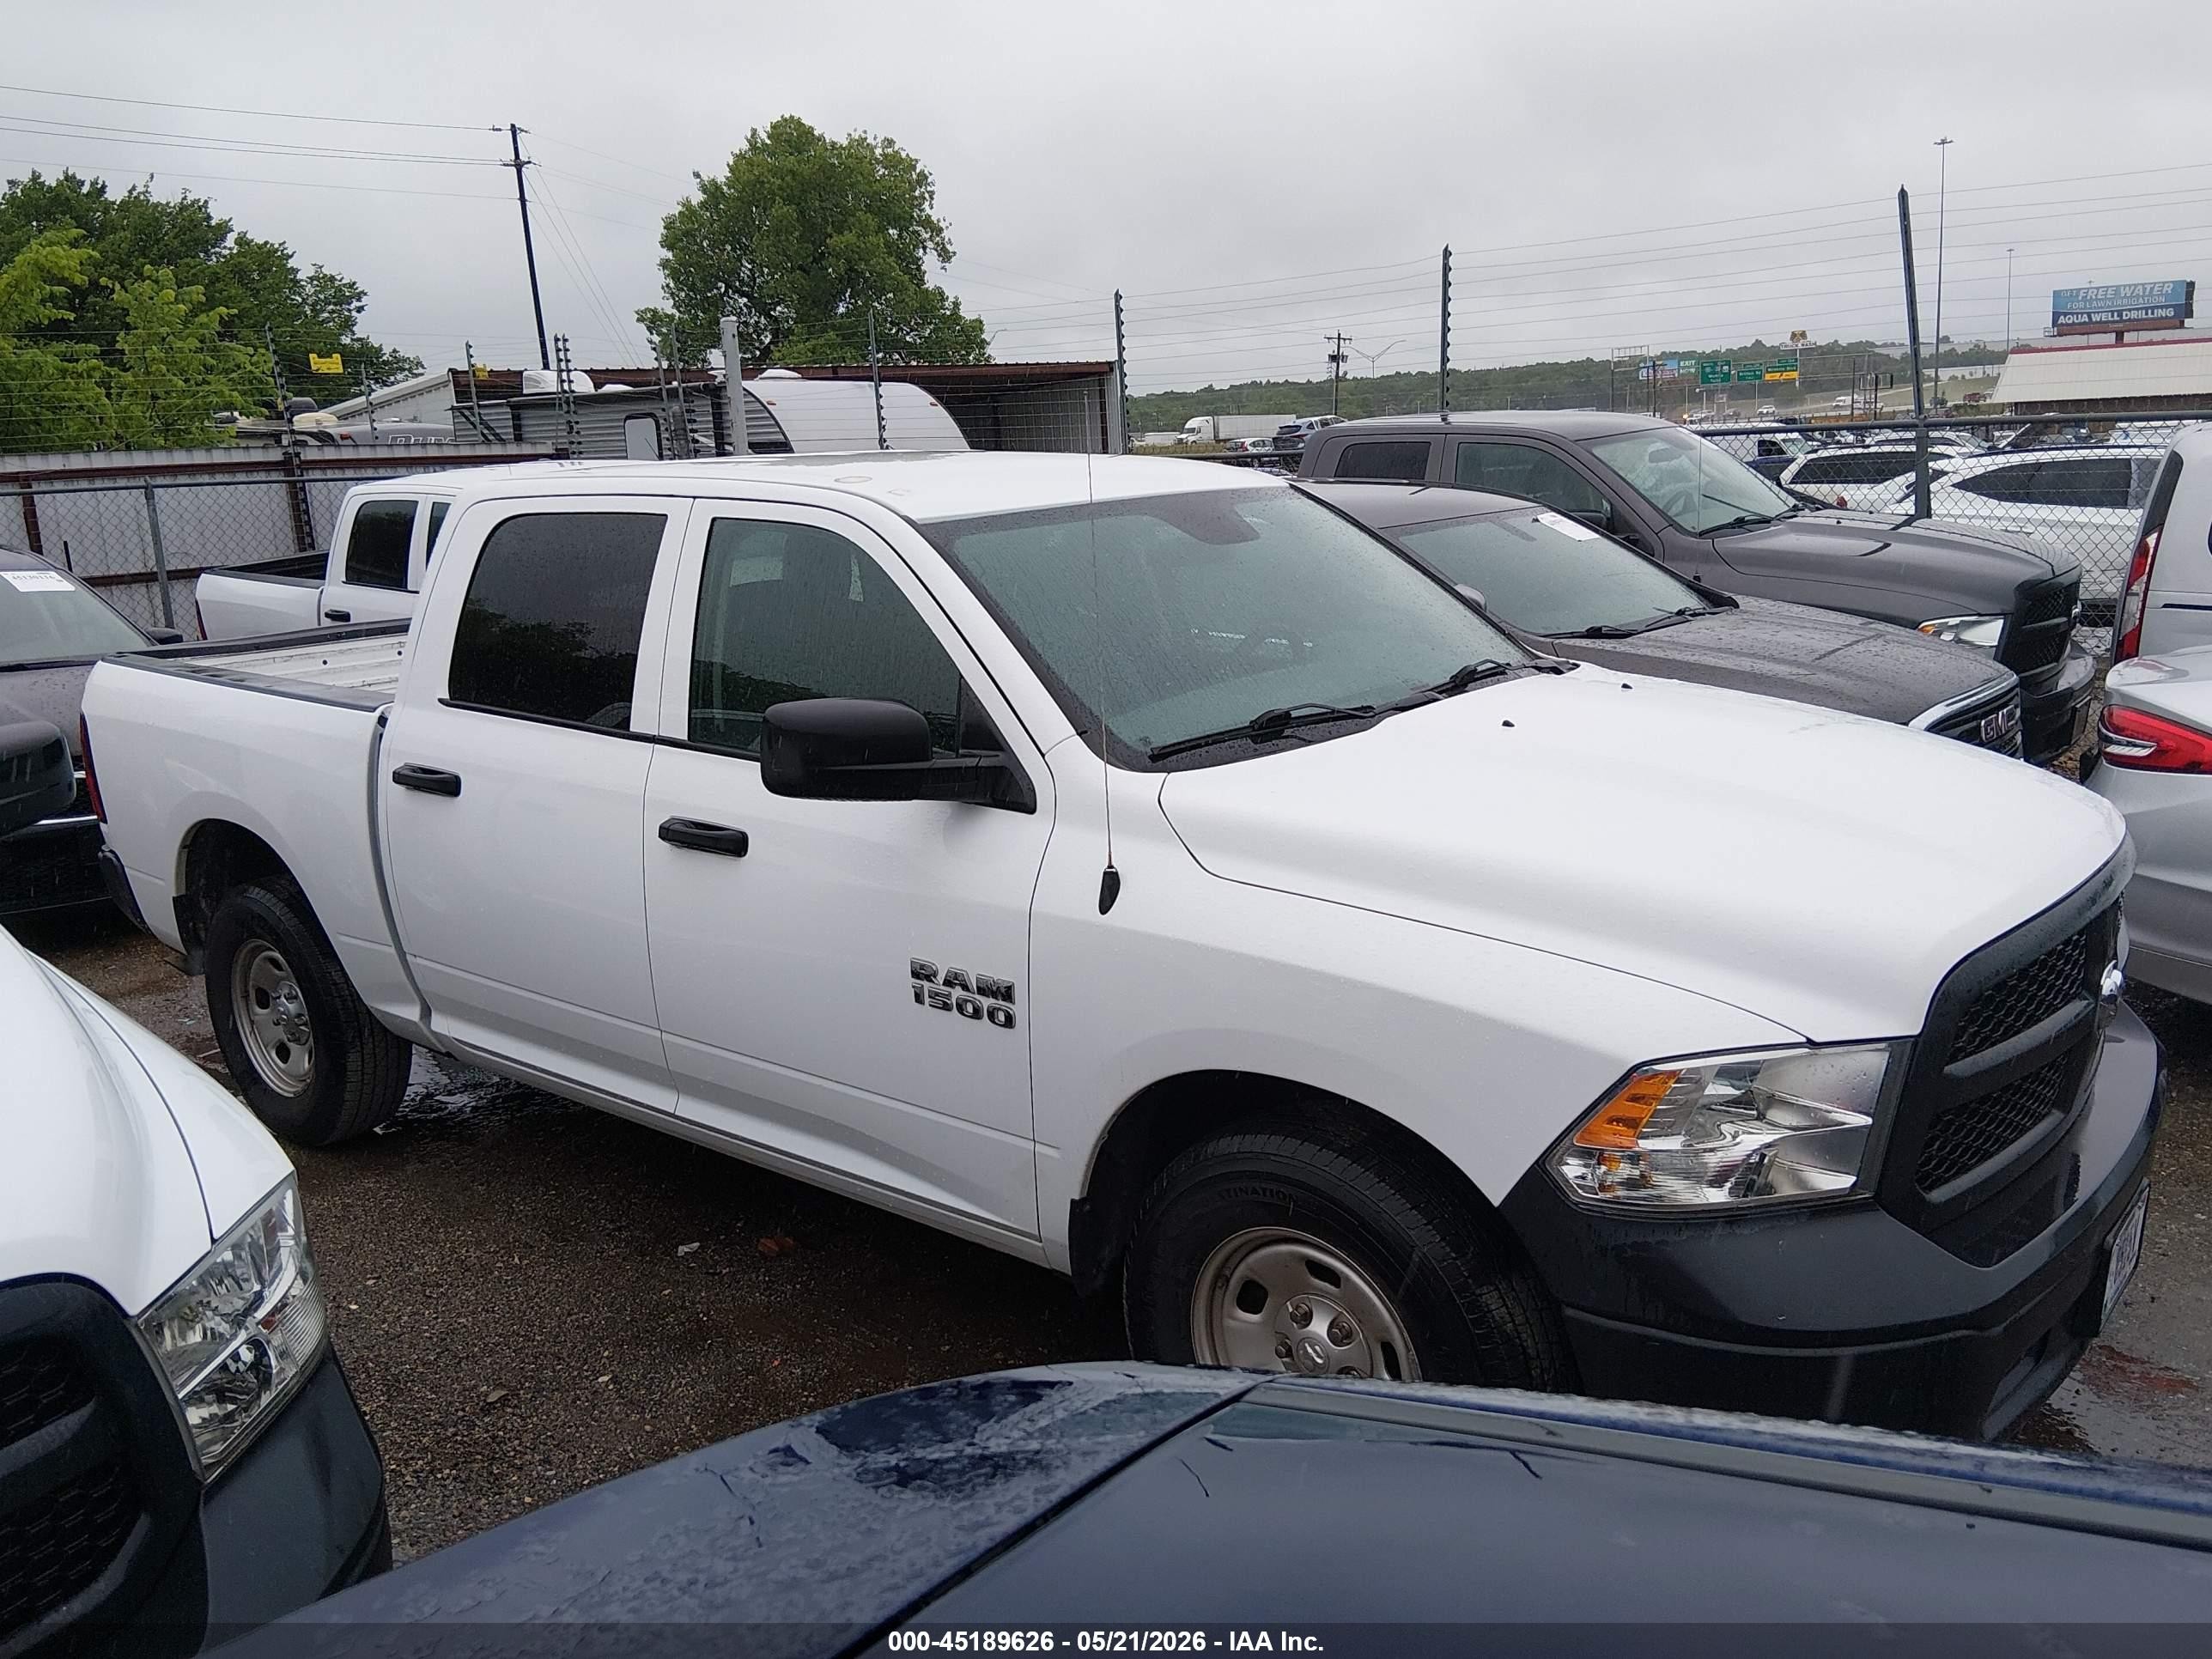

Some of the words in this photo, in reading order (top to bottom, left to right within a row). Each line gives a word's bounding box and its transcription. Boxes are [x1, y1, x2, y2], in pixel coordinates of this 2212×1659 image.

[2078, 287, 2116, 301] FREE
[2120, 283, 2173, 297] WATER
[2087, 299, 2112, 308] LAWN
[2113, 295, 2166, 306] IRRIGATION
[2057, 313, 2088, 324] AQUA
[2091, 311, 2120, 322] WELL
[2122, 307, 2174, 320] DRILLING
[1980, 704, 2019, 743] GMC
[910, 957, 1016, 1006] RAM
[911, 981, 1017, 1030] 1500
